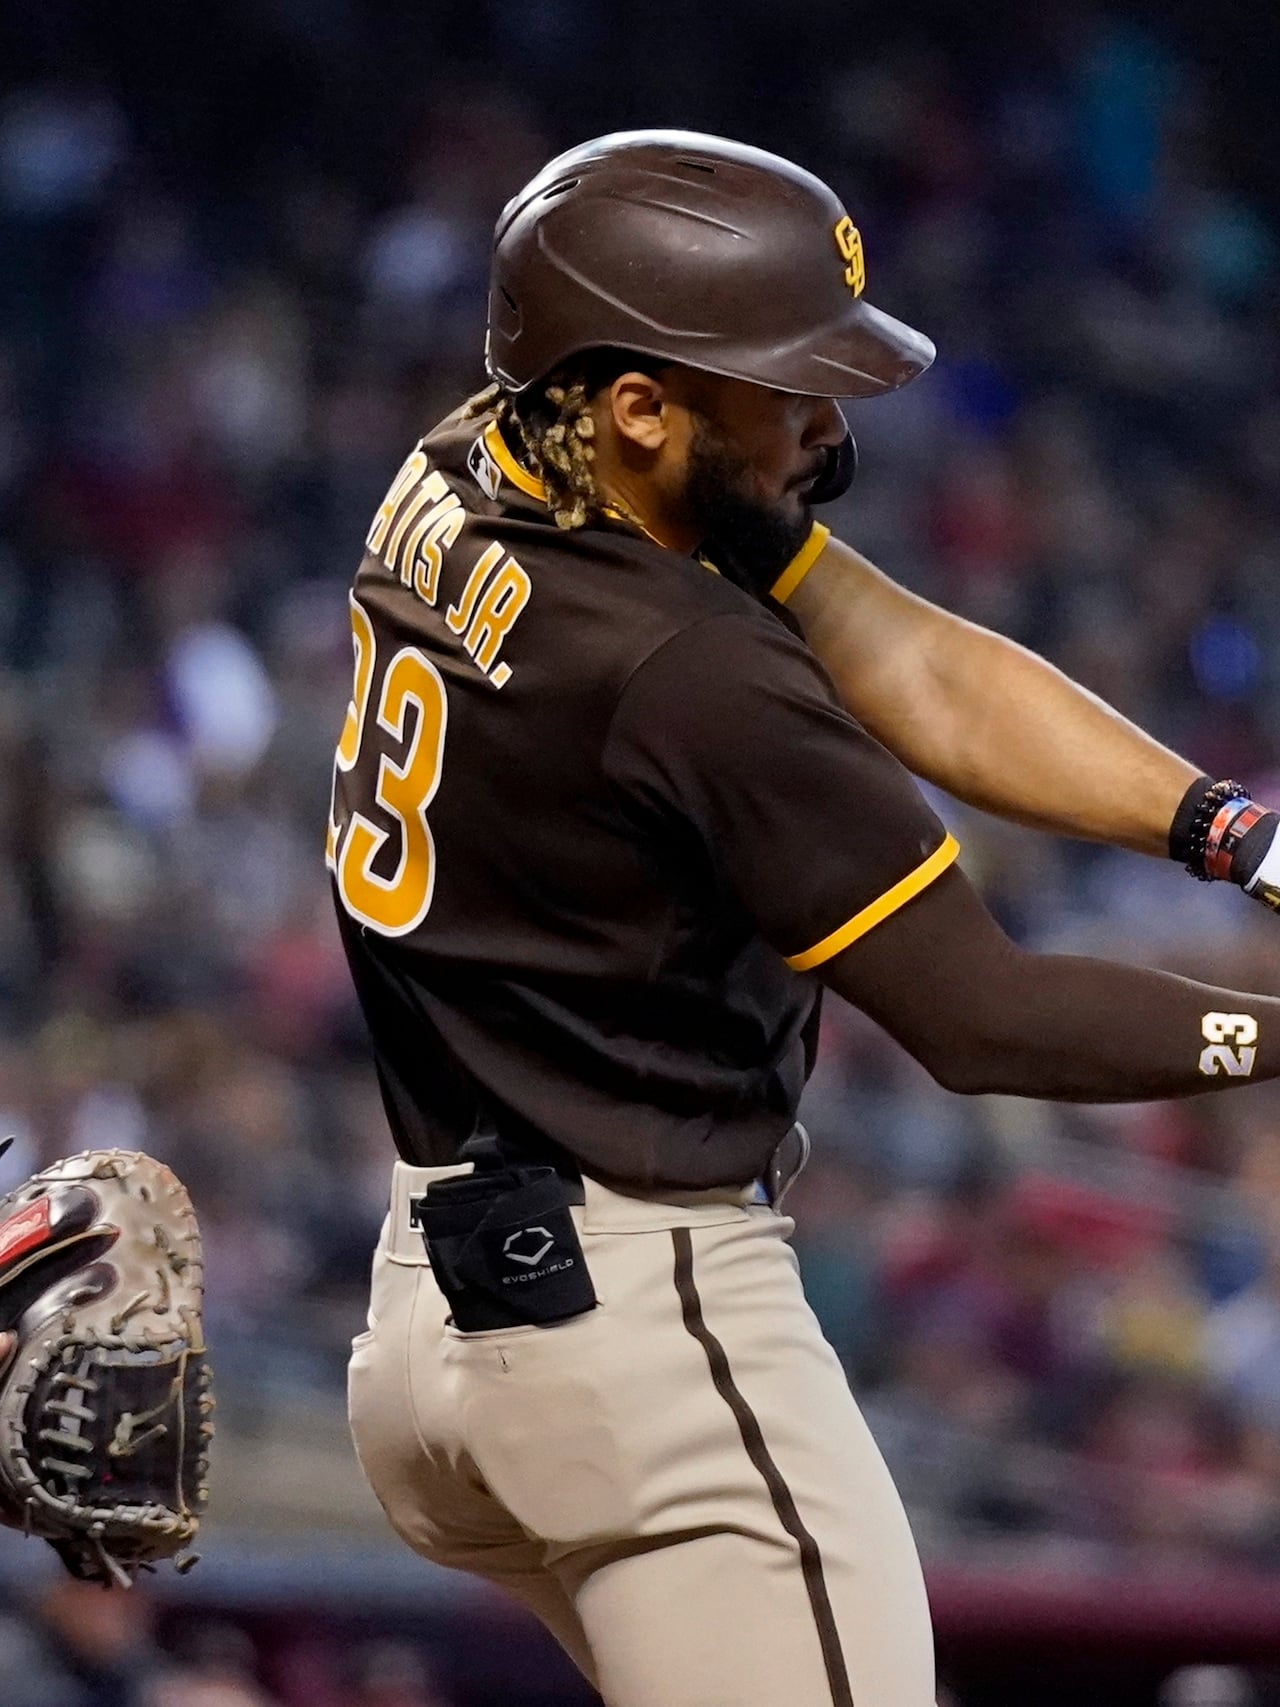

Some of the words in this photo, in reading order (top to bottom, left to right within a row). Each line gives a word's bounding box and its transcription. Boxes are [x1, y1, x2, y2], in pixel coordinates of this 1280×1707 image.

[365, 438, 466, 607] ATIS
[446, 541, 532, 690] JR.
[1199, 1010, 1259, 1077] 23
